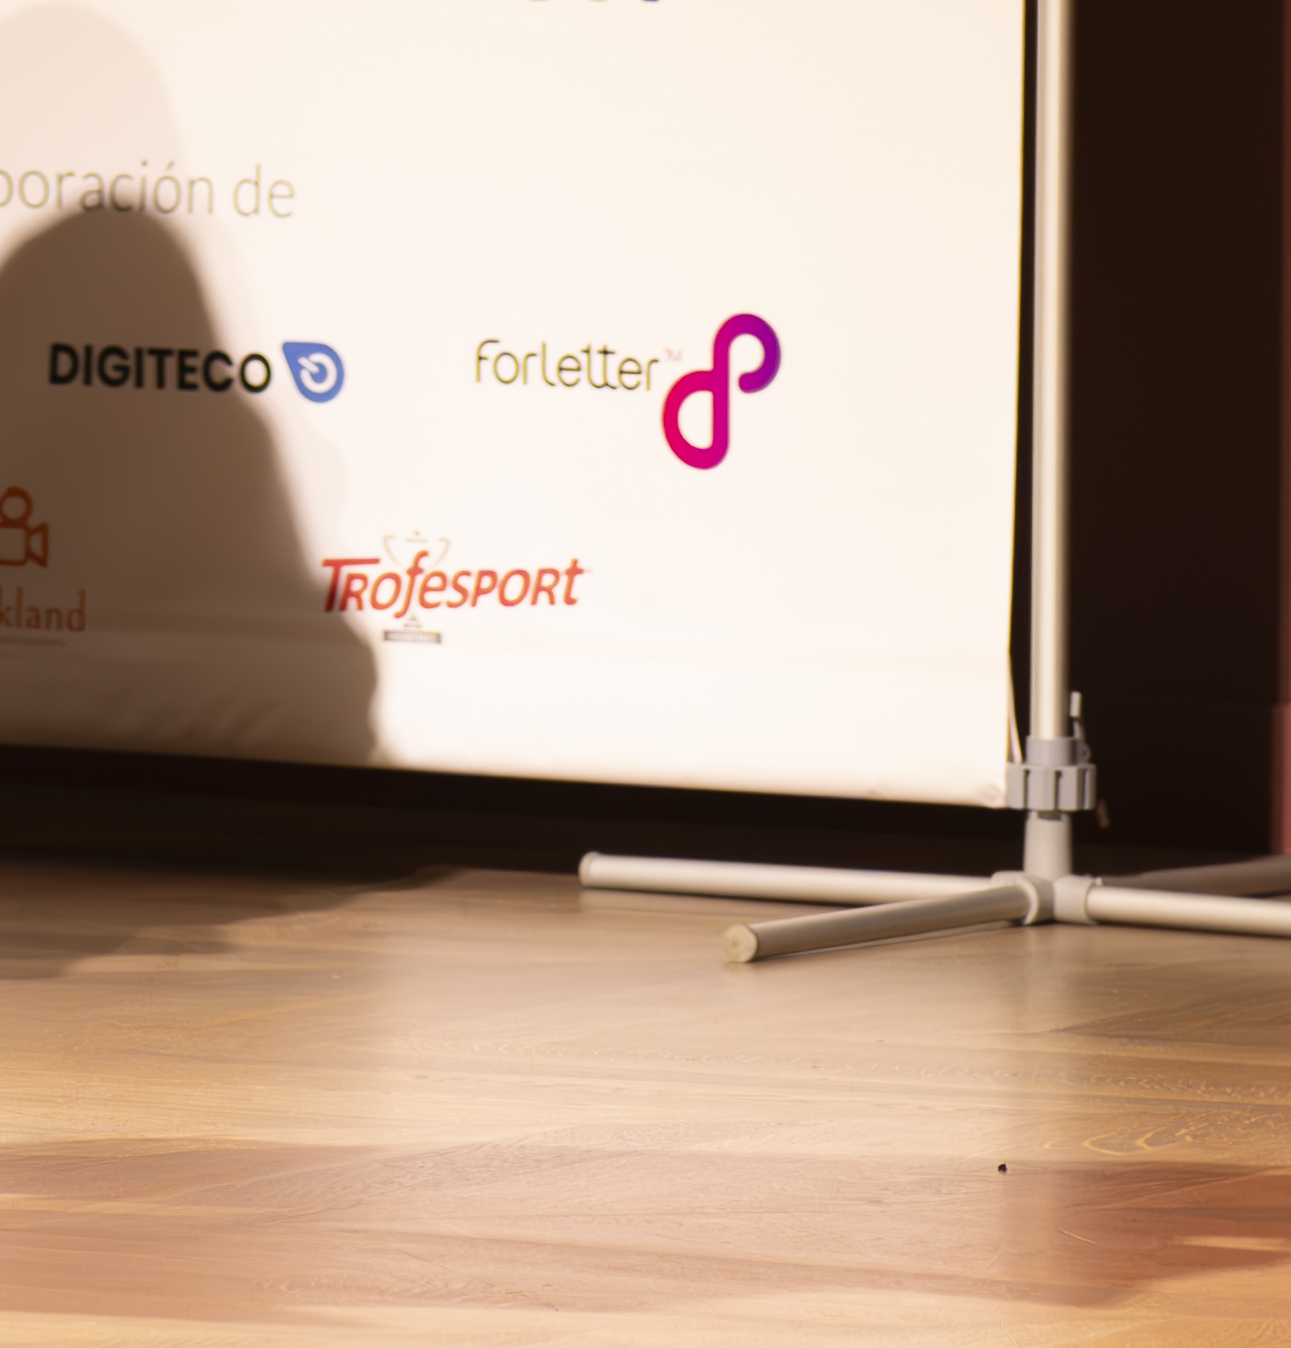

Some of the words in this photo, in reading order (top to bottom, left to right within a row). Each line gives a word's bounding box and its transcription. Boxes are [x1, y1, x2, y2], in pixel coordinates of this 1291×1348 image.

[232, 163, 296, 219] de
[48, 343, 271, 393] DIGITECO
[476, 339, 659, 391] forletter
